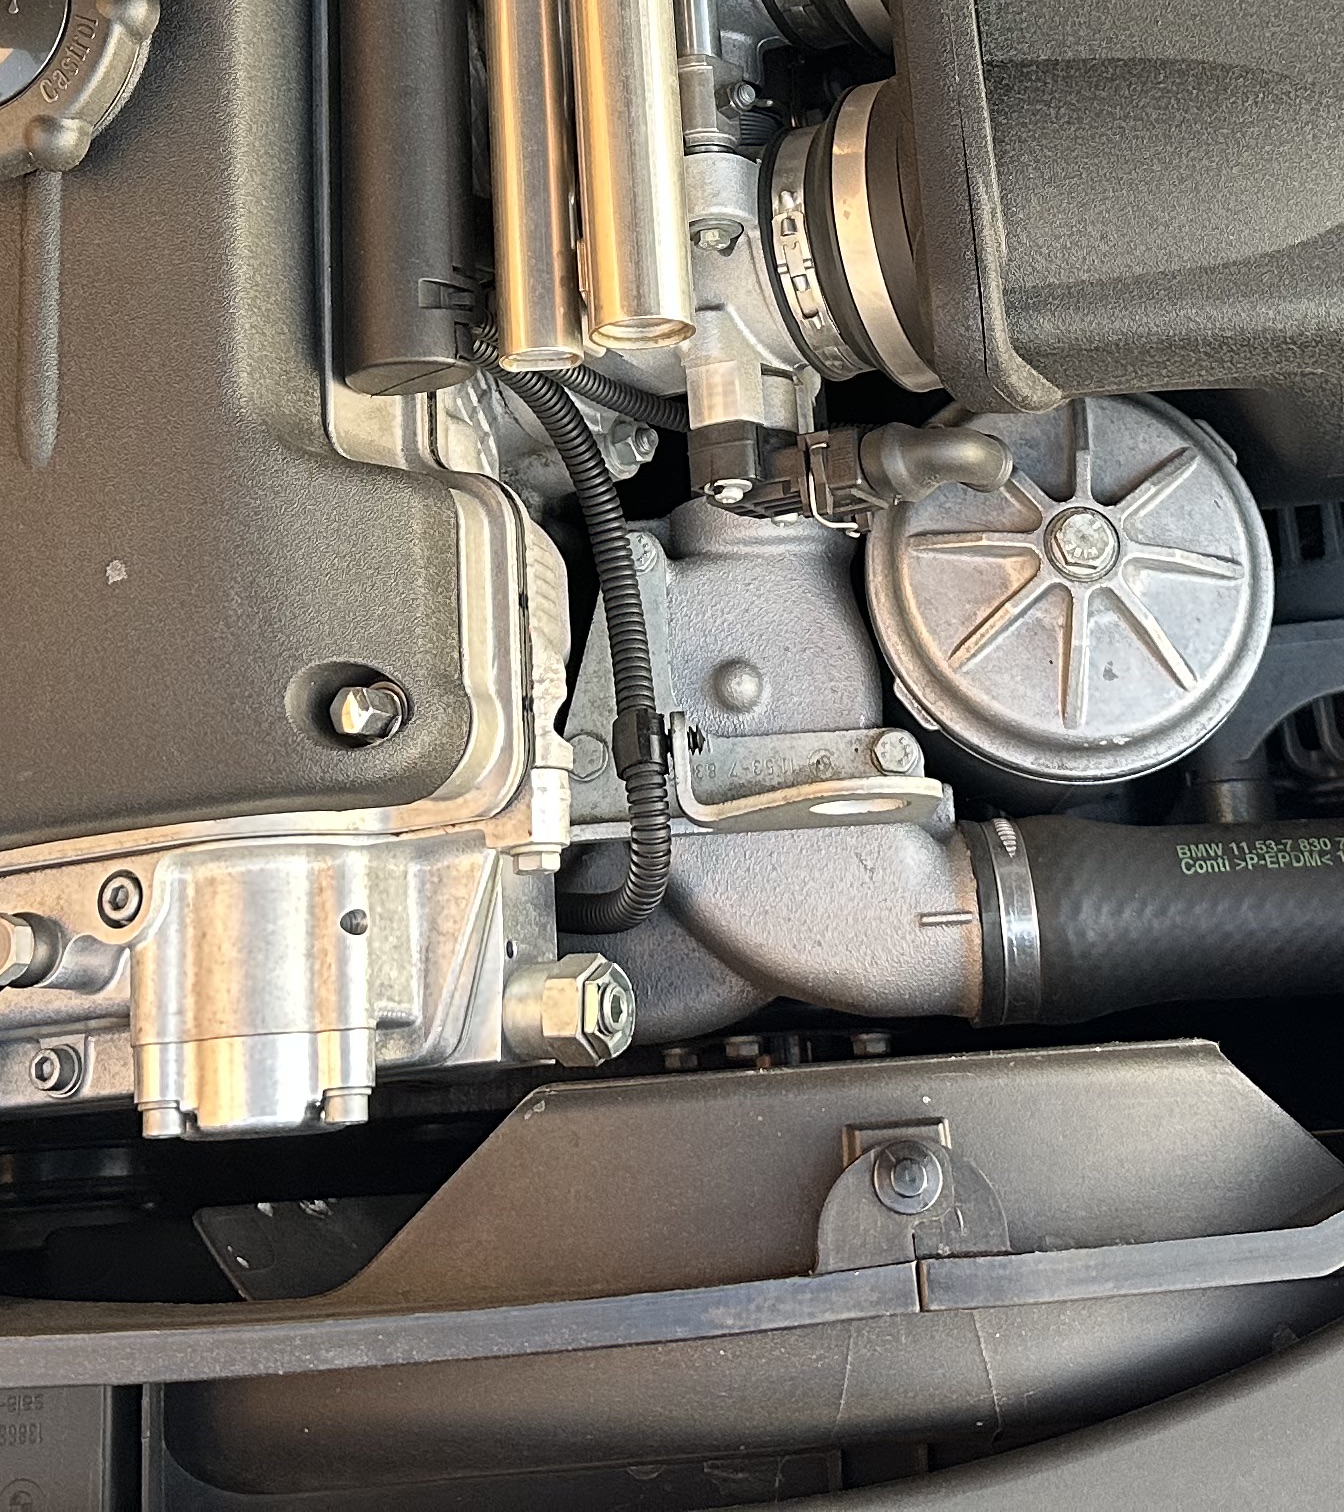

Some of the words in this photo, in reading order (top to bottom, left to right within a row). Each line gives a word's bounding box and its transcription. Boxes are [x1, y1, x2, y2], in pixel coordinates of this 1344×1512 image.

[39, 14, 99, 104] Castrol
[1176, 842, 1223, 859] BMW
[1229, 839, 1293, 856] 11.53-7
[1299, 838, 1331, 851] 830
[1181, 856, 1230, 875] Conti
[1234, 851, 1333, 871] >P-EPDM<
